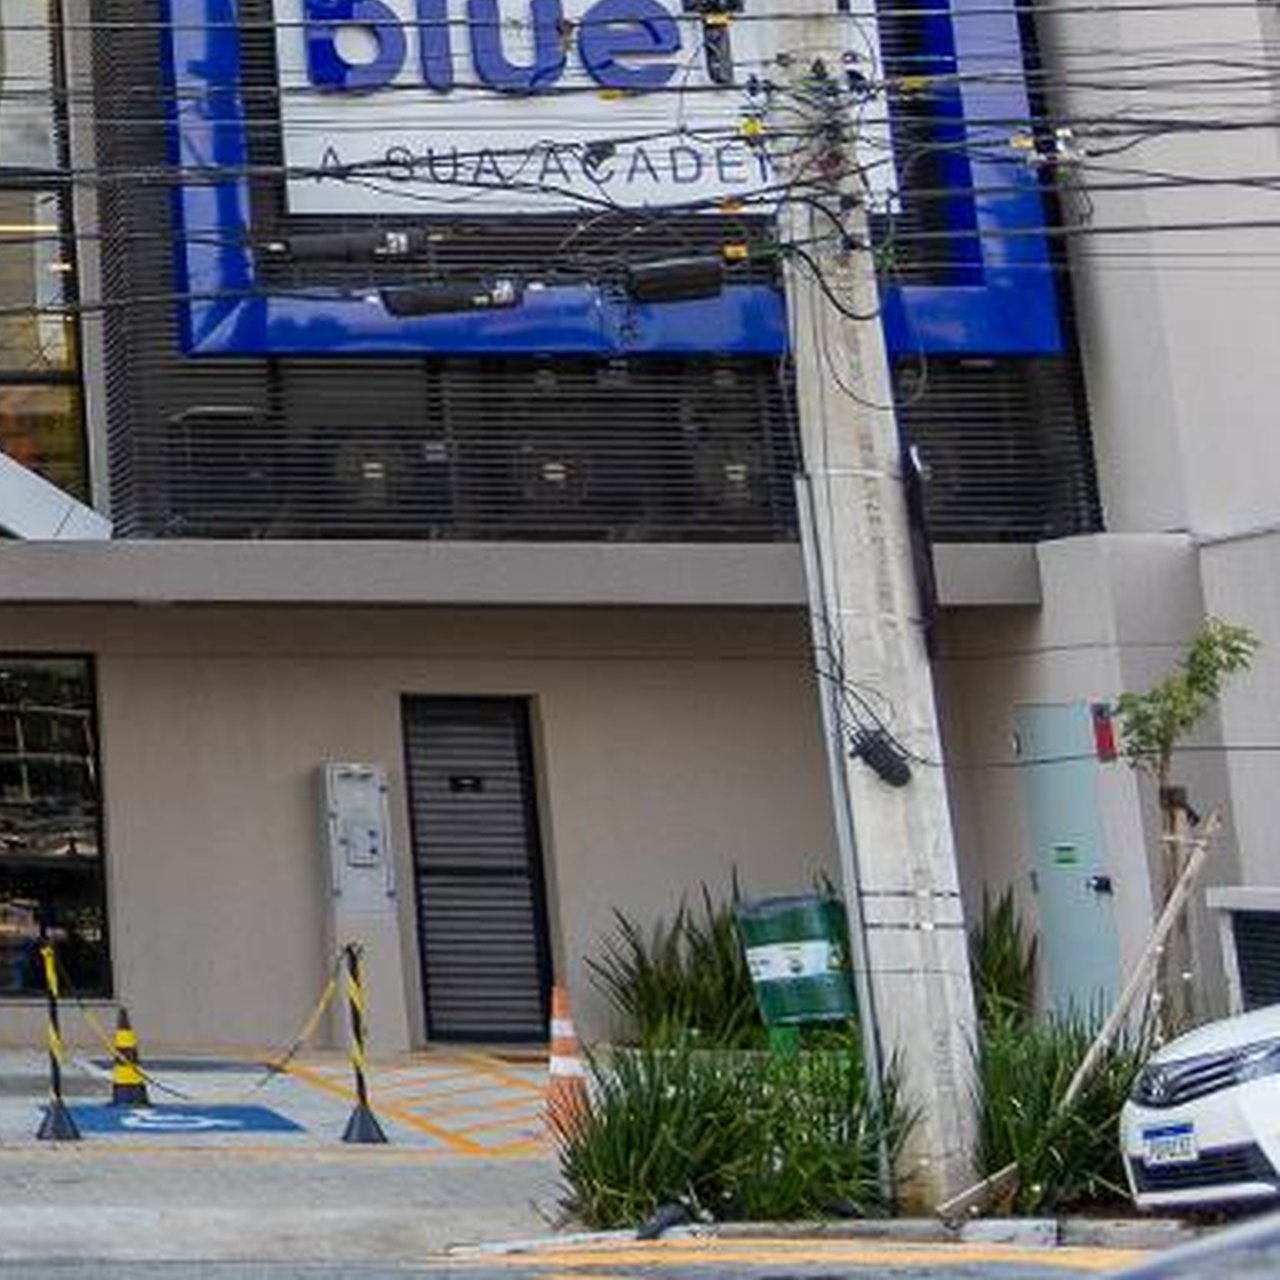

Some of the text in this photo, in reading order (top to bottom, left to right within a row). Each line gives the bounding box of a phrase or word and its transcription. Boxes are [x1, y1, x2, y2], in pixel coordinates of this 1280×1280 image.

[316, 145, 870, 185] A SUA ACADE
